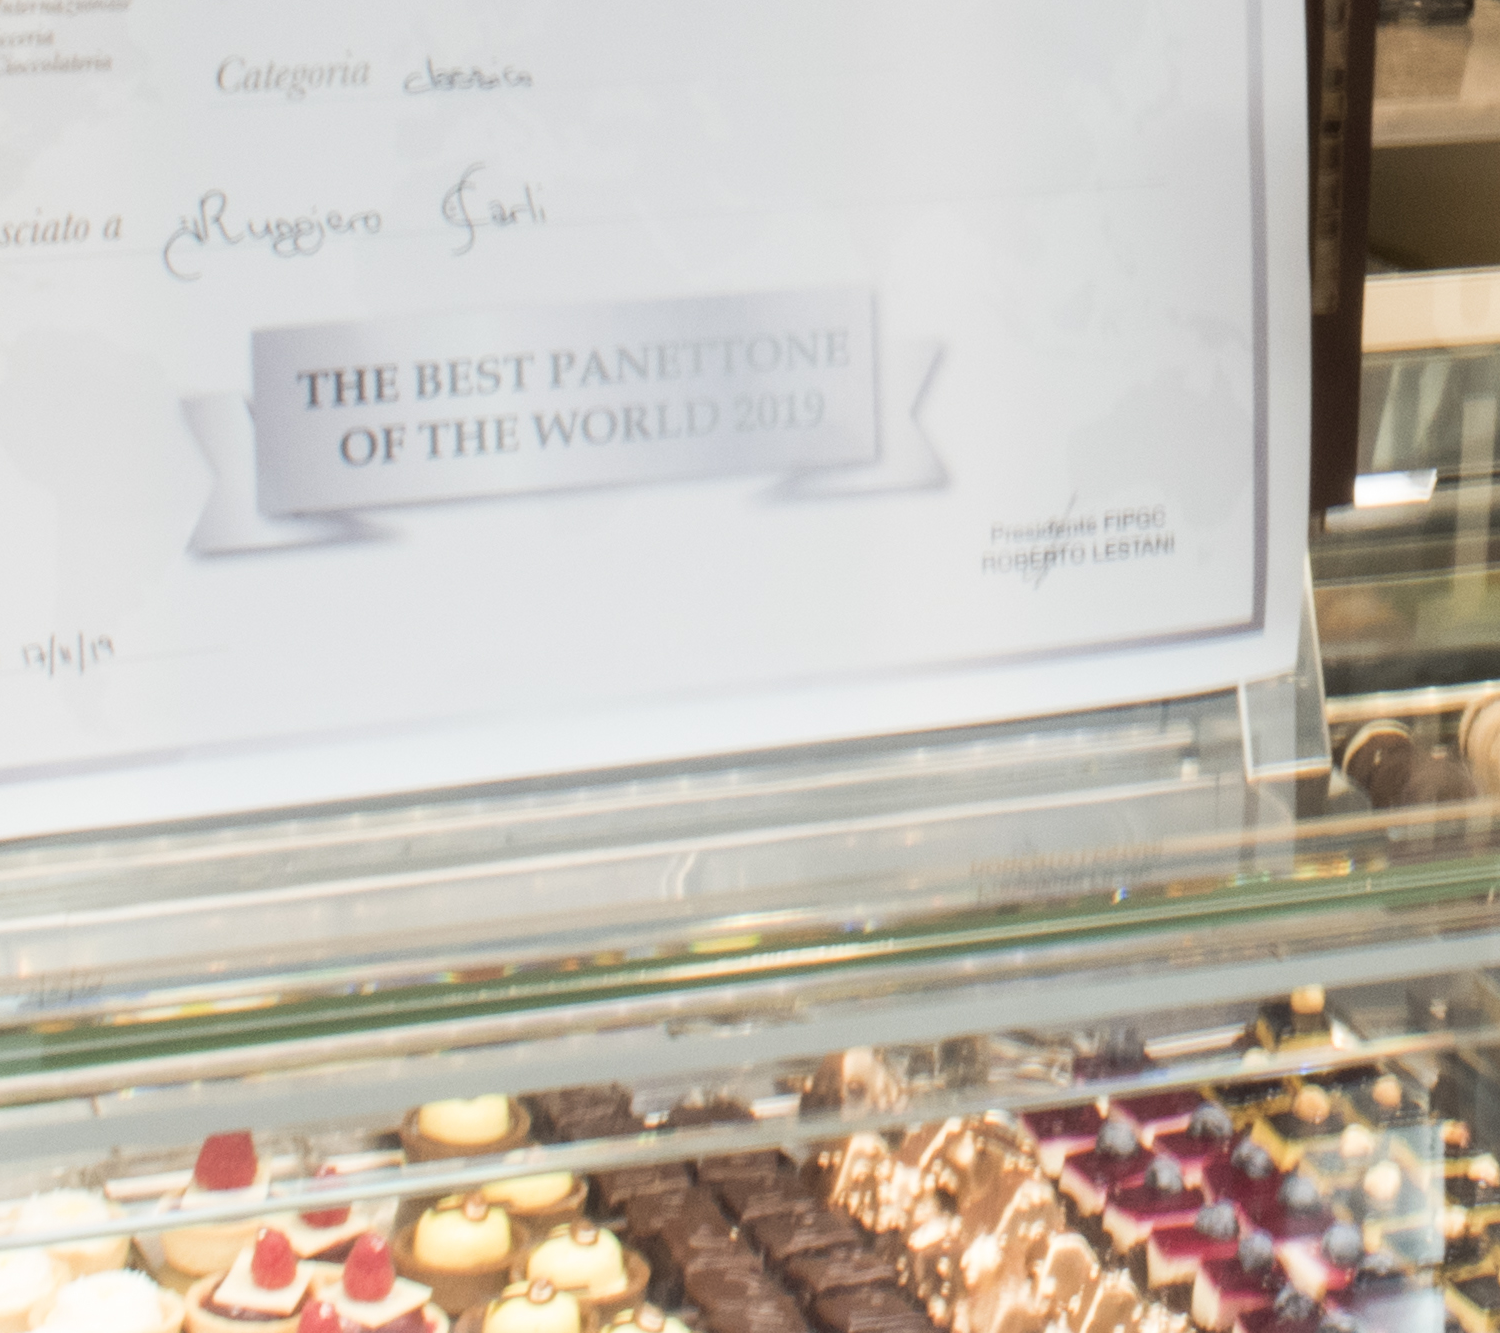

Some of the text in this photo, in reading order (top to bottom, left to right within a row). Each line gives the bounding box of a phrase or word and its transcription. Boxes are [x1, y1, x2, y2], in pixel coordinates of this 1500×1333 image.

[216, 49, 371, 102] Categoria
[102, 213, 124, 243] a
[299, 328, 851, 412] THE BEST PANETTONE
[339, 389, 827, 469] OF THE WORLD 2019
[981, 530, 1176, 575] ROBERTO LESTANI
